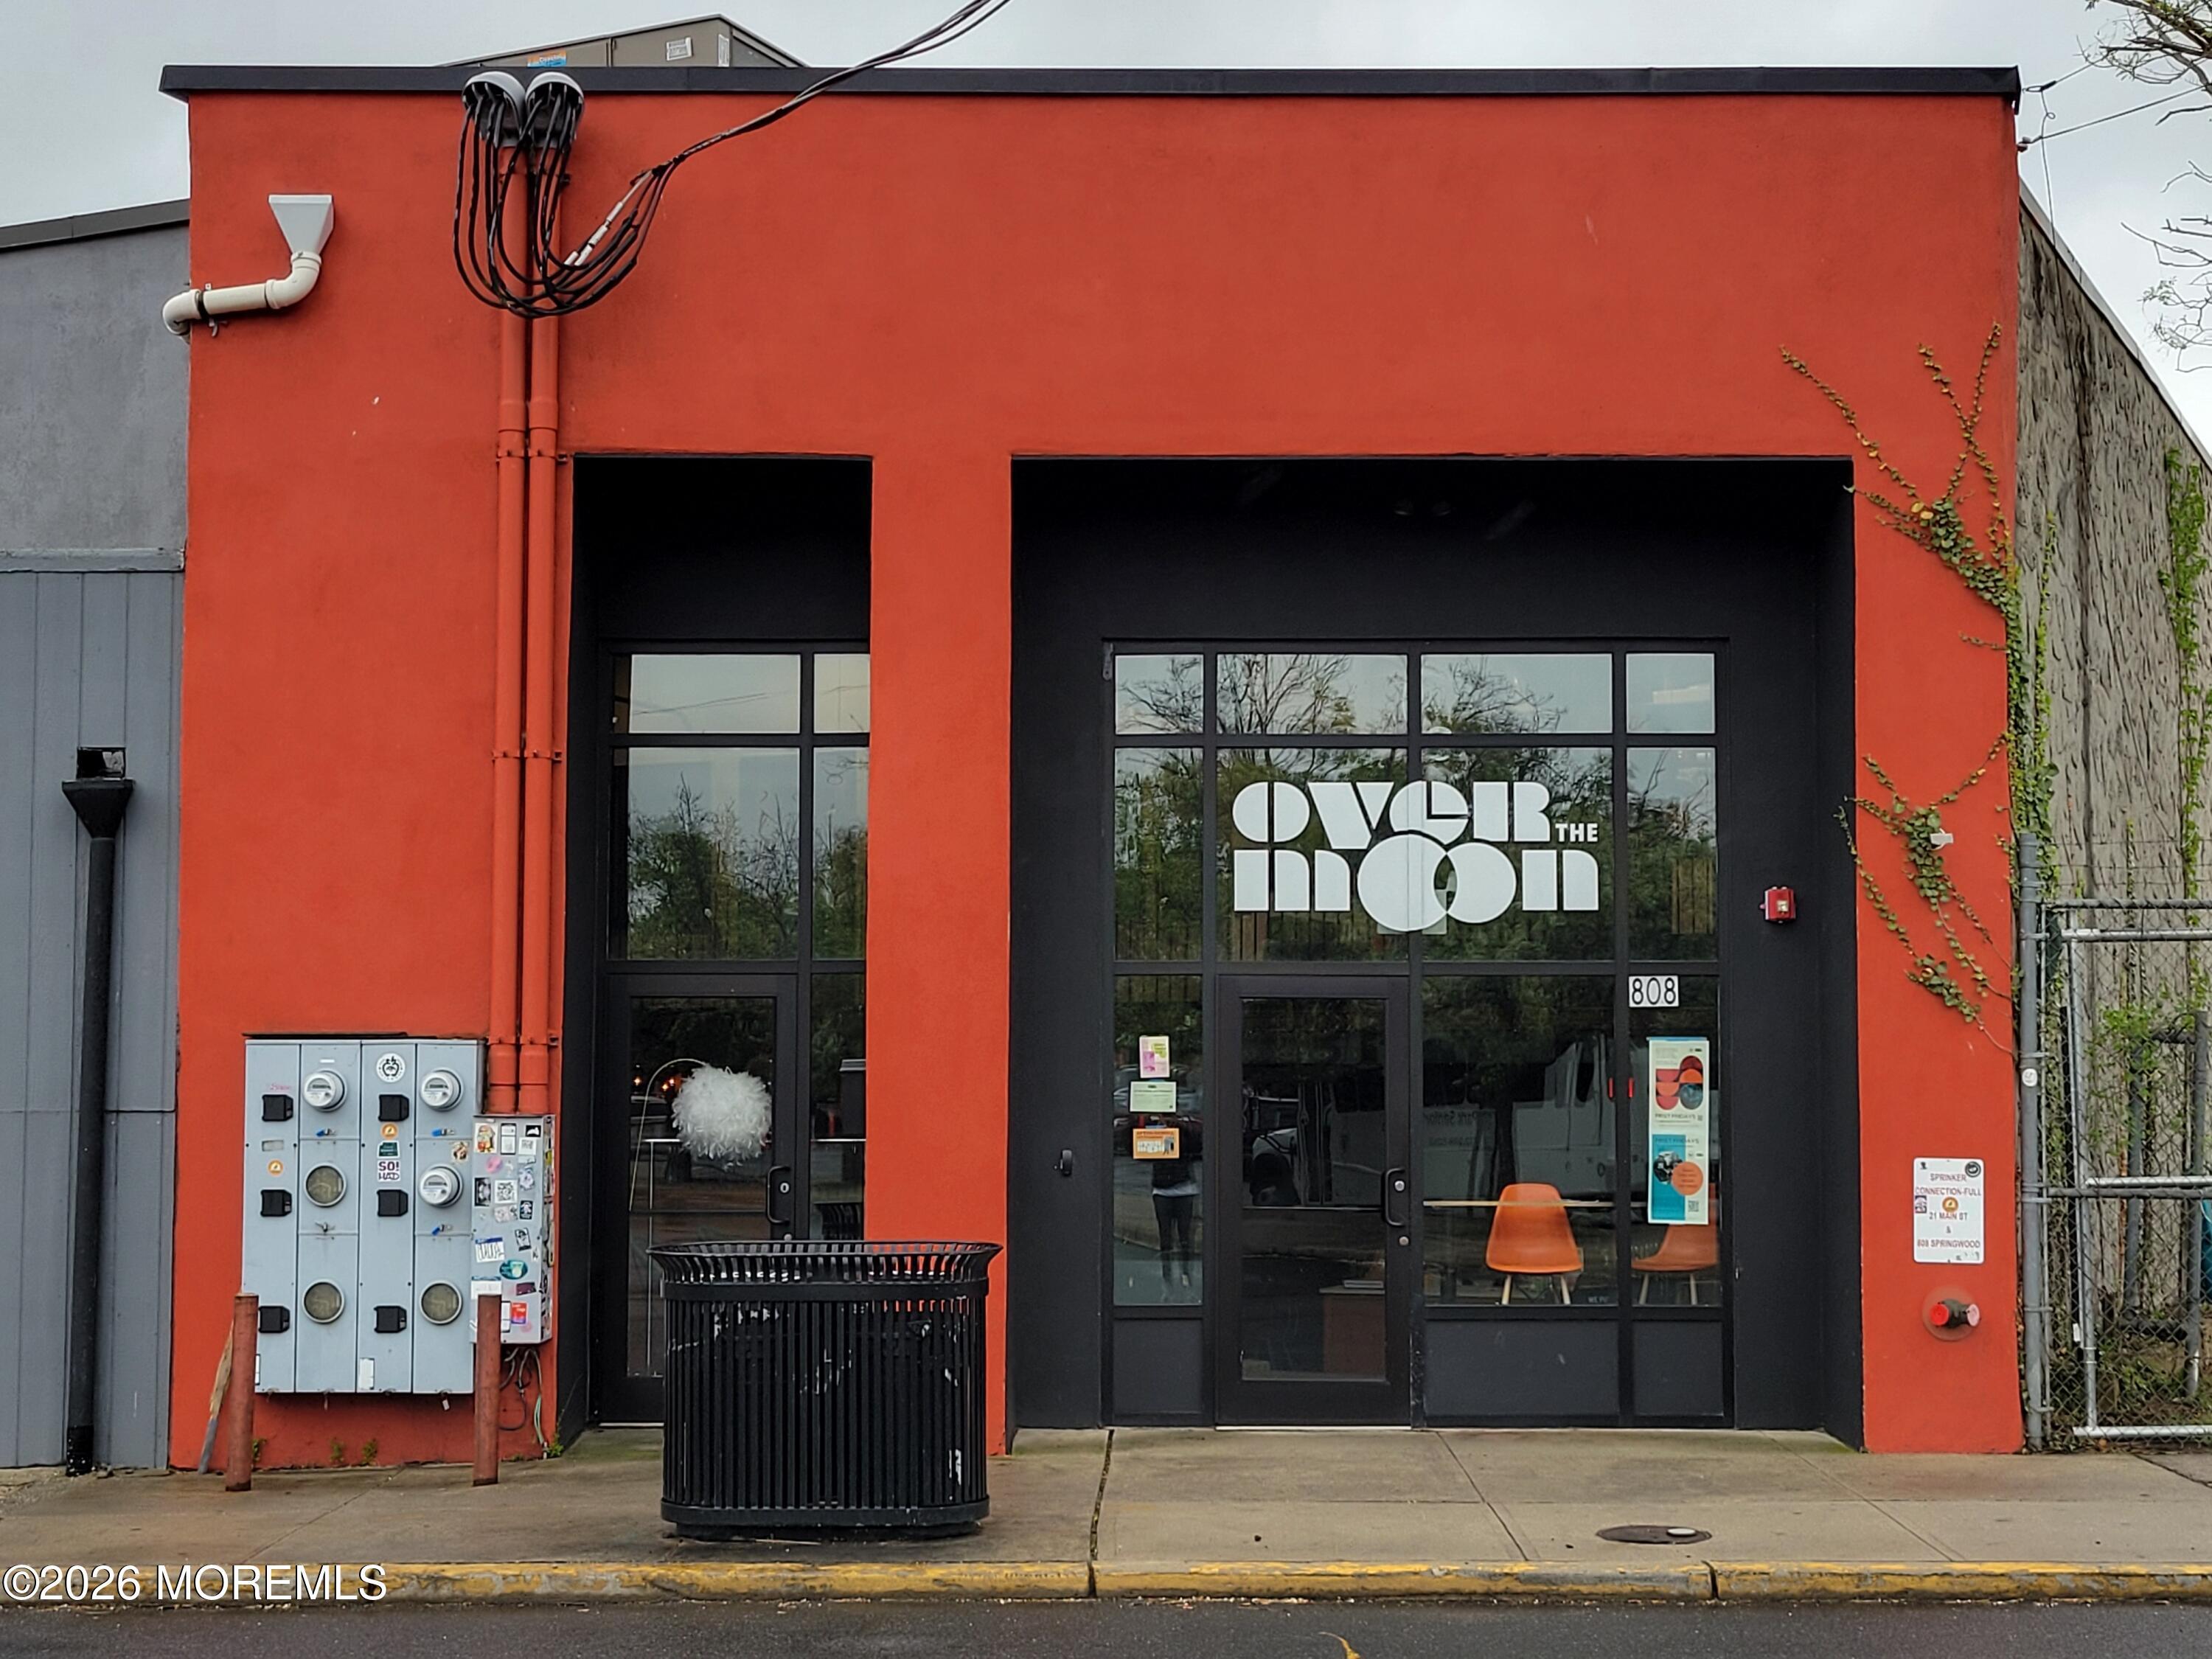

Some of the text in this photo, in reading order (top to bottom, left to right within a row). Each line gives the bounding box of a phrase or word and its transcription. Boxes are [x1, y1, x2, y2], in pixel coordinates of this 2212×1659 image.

[1232, 781, 1551, 849] OVER
[1555, 823, 1598, 843] THE
[1233, 833, 1599, 932] MOON
[1632, 978, 1676, 1005] 808
[1930, 1173, 1967, 1182] SPRINKER
[1915, 1186, 1981, 1196] CONNECTION-FULL
[1929, 1212, 1968, 1220] 21 MAIN ST
[1930, 1239, 1981, 1248] SPRINGWOOD
